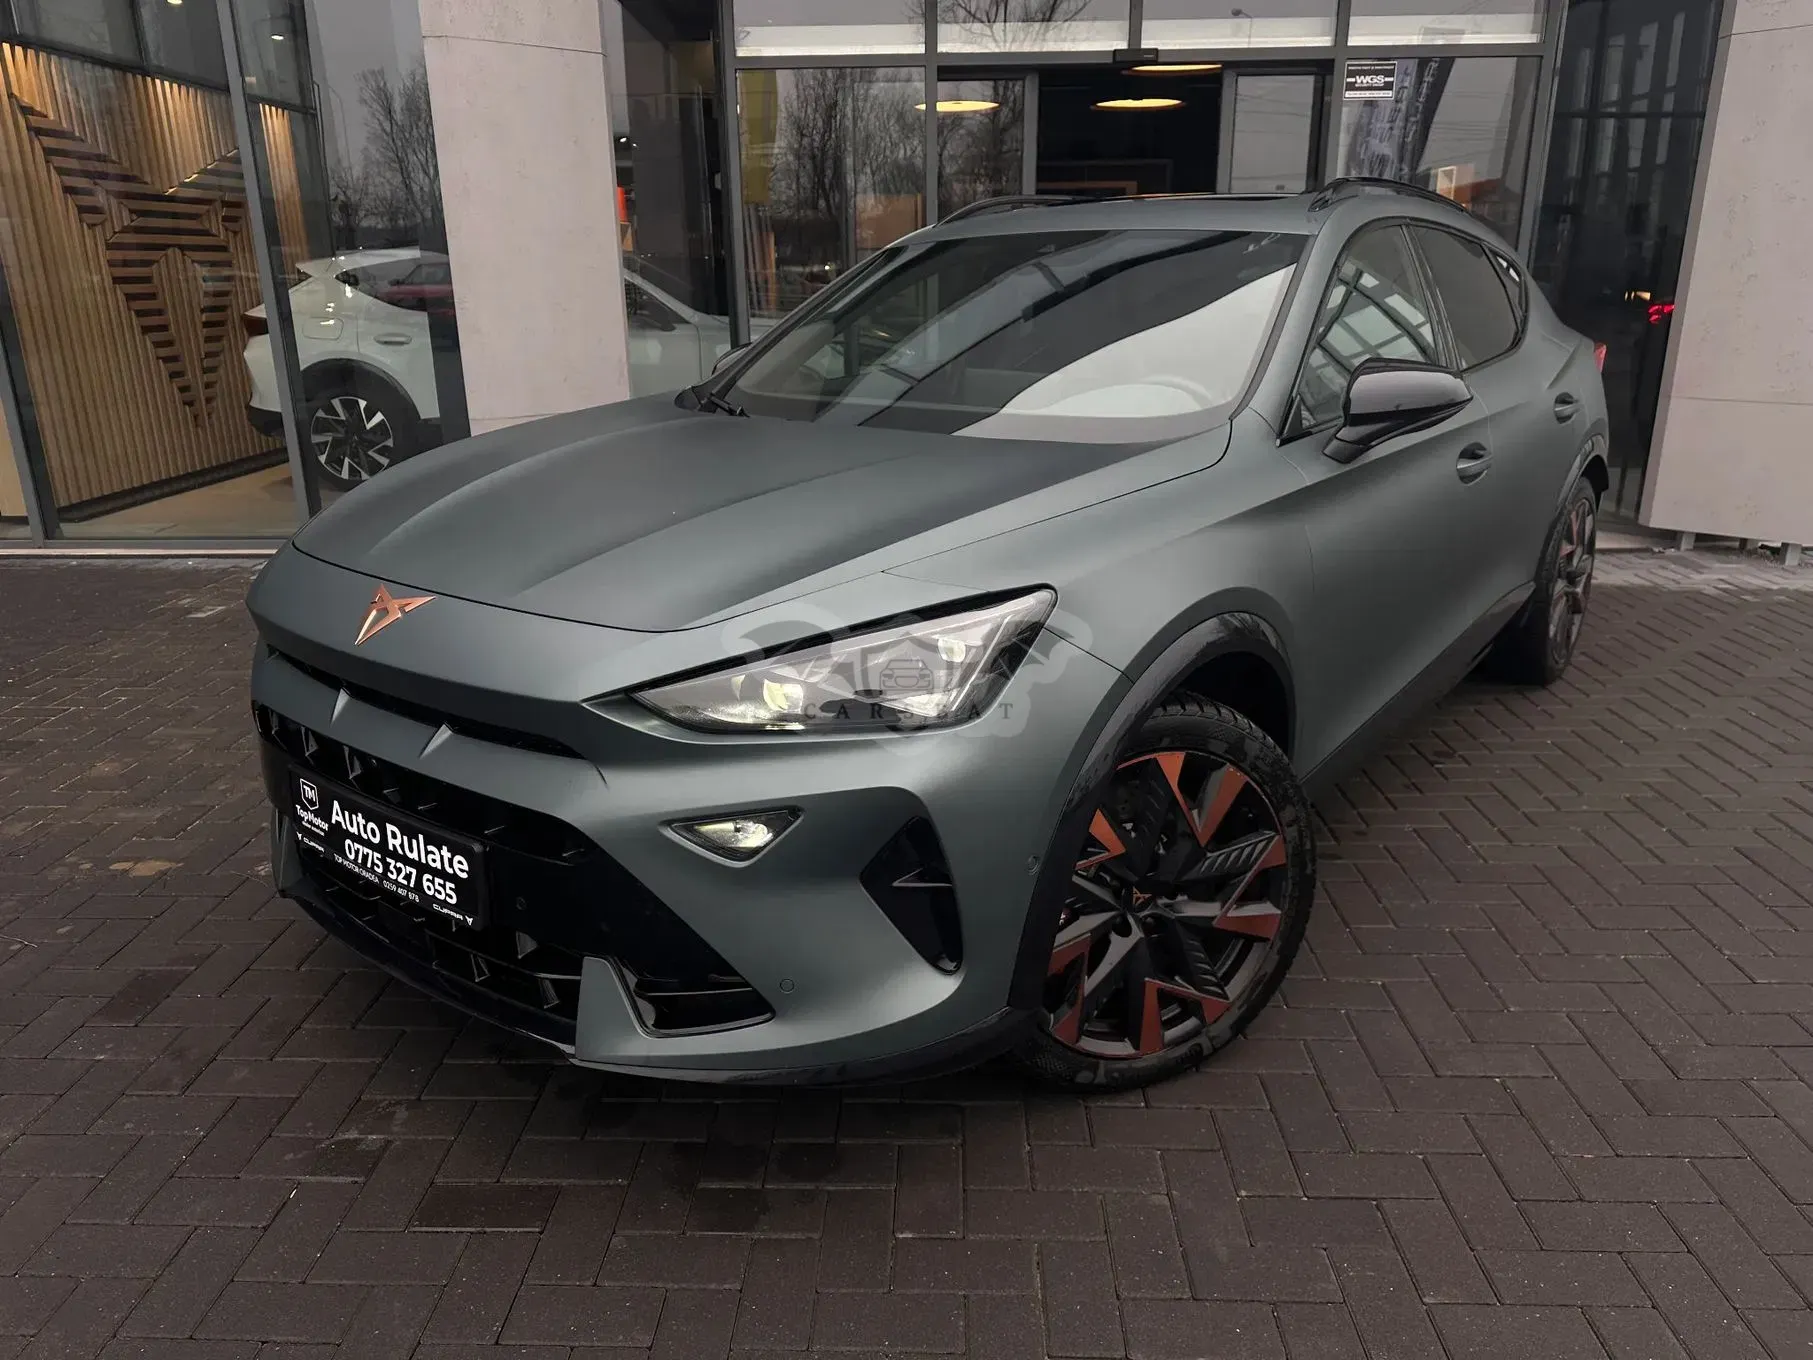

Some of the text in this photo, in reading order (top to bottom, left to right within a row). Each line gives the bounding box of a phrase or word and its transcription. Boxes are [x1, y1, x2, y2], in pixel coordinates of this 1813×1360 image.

[1355, 75, 1385, 84] WGS
[303, 784, 316, 802] TM
[331, 799, 470, 879] Auto Rulate
[344, 838, 458, 905] 0775 327 655
